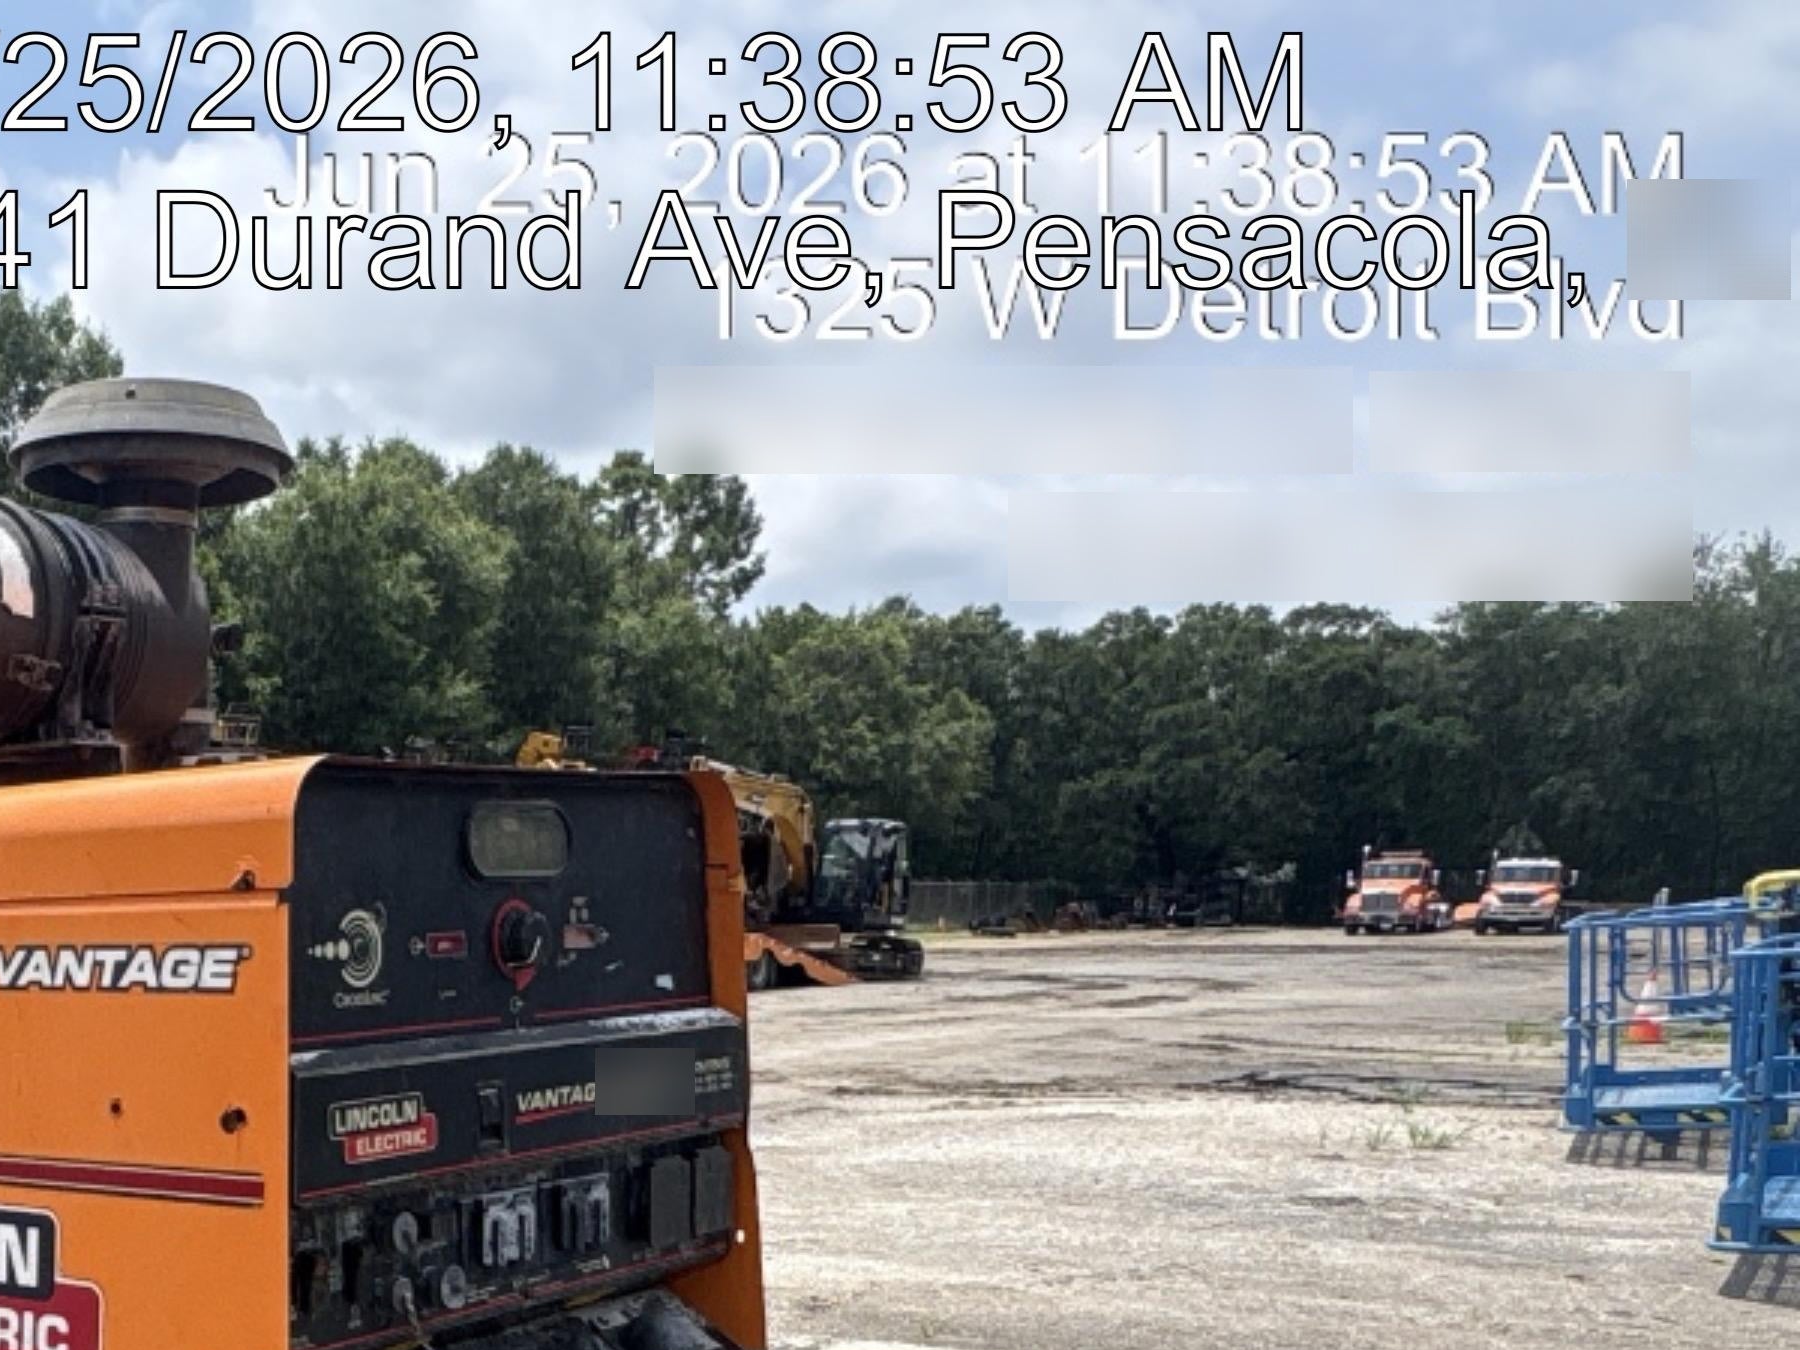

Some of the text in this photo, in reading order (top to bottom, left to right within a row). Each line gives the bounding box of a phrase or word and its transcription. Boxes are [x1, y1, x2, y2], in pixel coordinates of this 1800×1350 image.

[515, 1082, 596, 1112] VANTAG
[334, 1099, 418, 1134] LINCOLN
[355, 1128, 427, 1156] ELECTRIC
